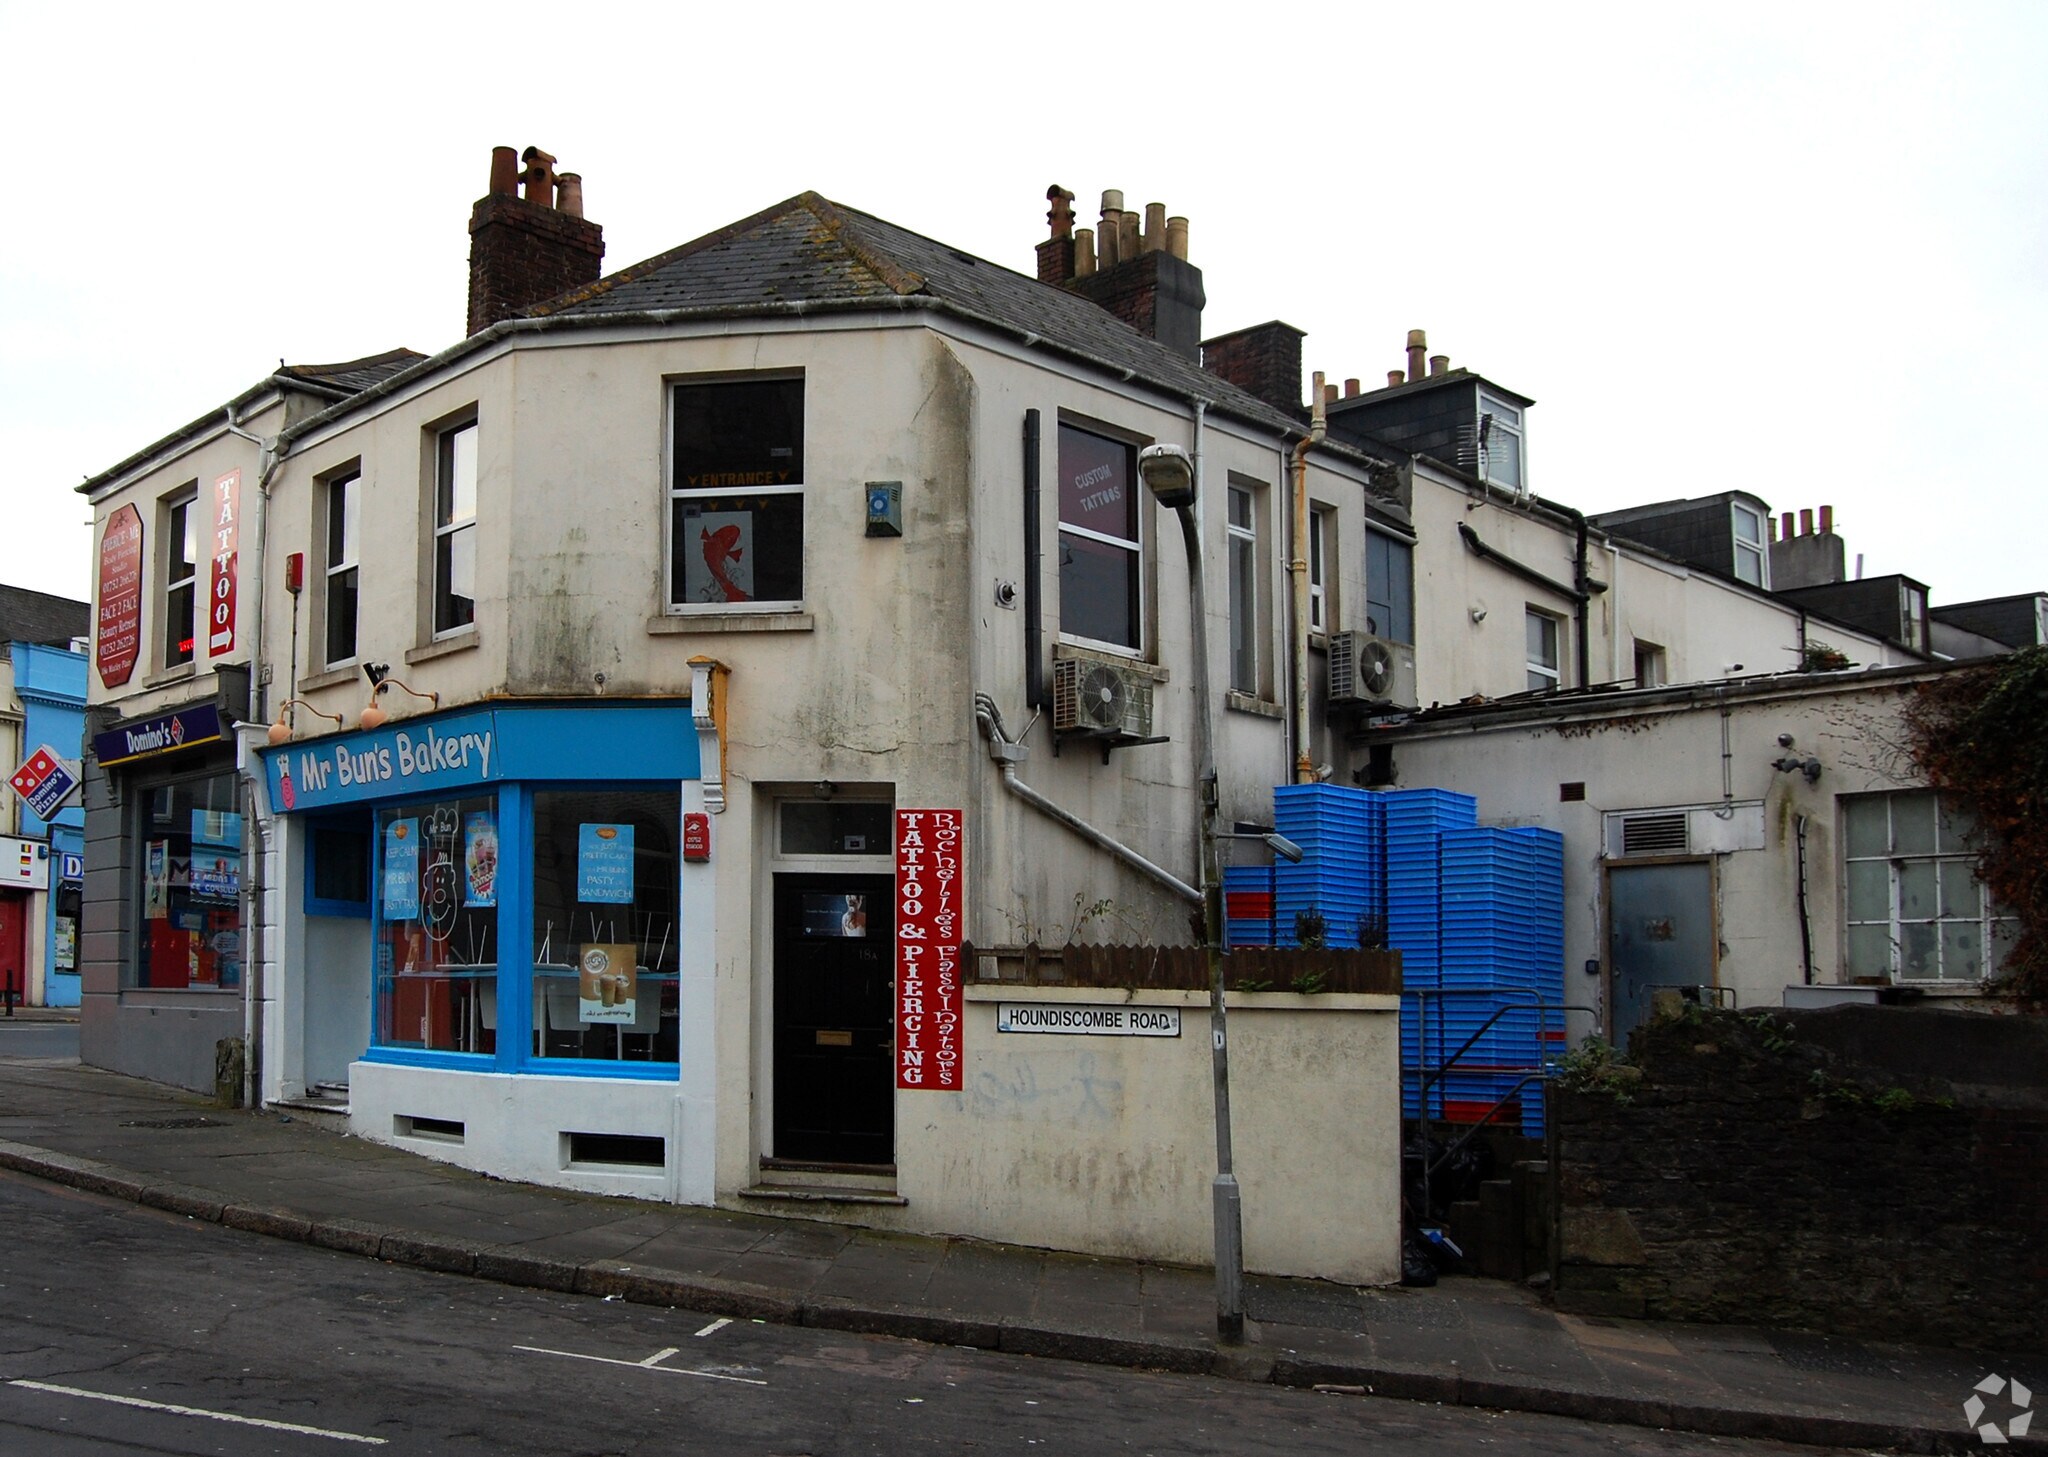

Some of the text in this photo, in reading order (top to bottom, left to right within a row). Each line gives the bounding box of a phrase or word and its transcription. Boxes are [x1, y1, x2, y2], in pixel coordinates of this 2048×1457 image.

[702, 471, 774, 487] ENTRANCE
[1074, 464, 1113, 489] CUSTOM
[1080, 486, 1121, 512] TATTOOS
[215, 477, 235, 625] TATTOO
[100, 603, 116, 622] FACE
[122, 594, 137, 614] FACE
[126, 722, 171, 754] Domino's
[302, 726, 492, 793] Mr Bun's Bakery
[28, 770, 63, 807] Domino's
[35, 791, 59, 814] Pizza
[440, 821, 452, 832] Bun
[580, 887, 632, 899] SANDWICH
[586, 876, 615, 885] PASTY
[898, 812, 928, 1084] TATTOO & PIERCING
[1009, 1009, 1123, 1028] HOUNDISCOMBE
[1129, 1012, 1170, 1030] ROAD
